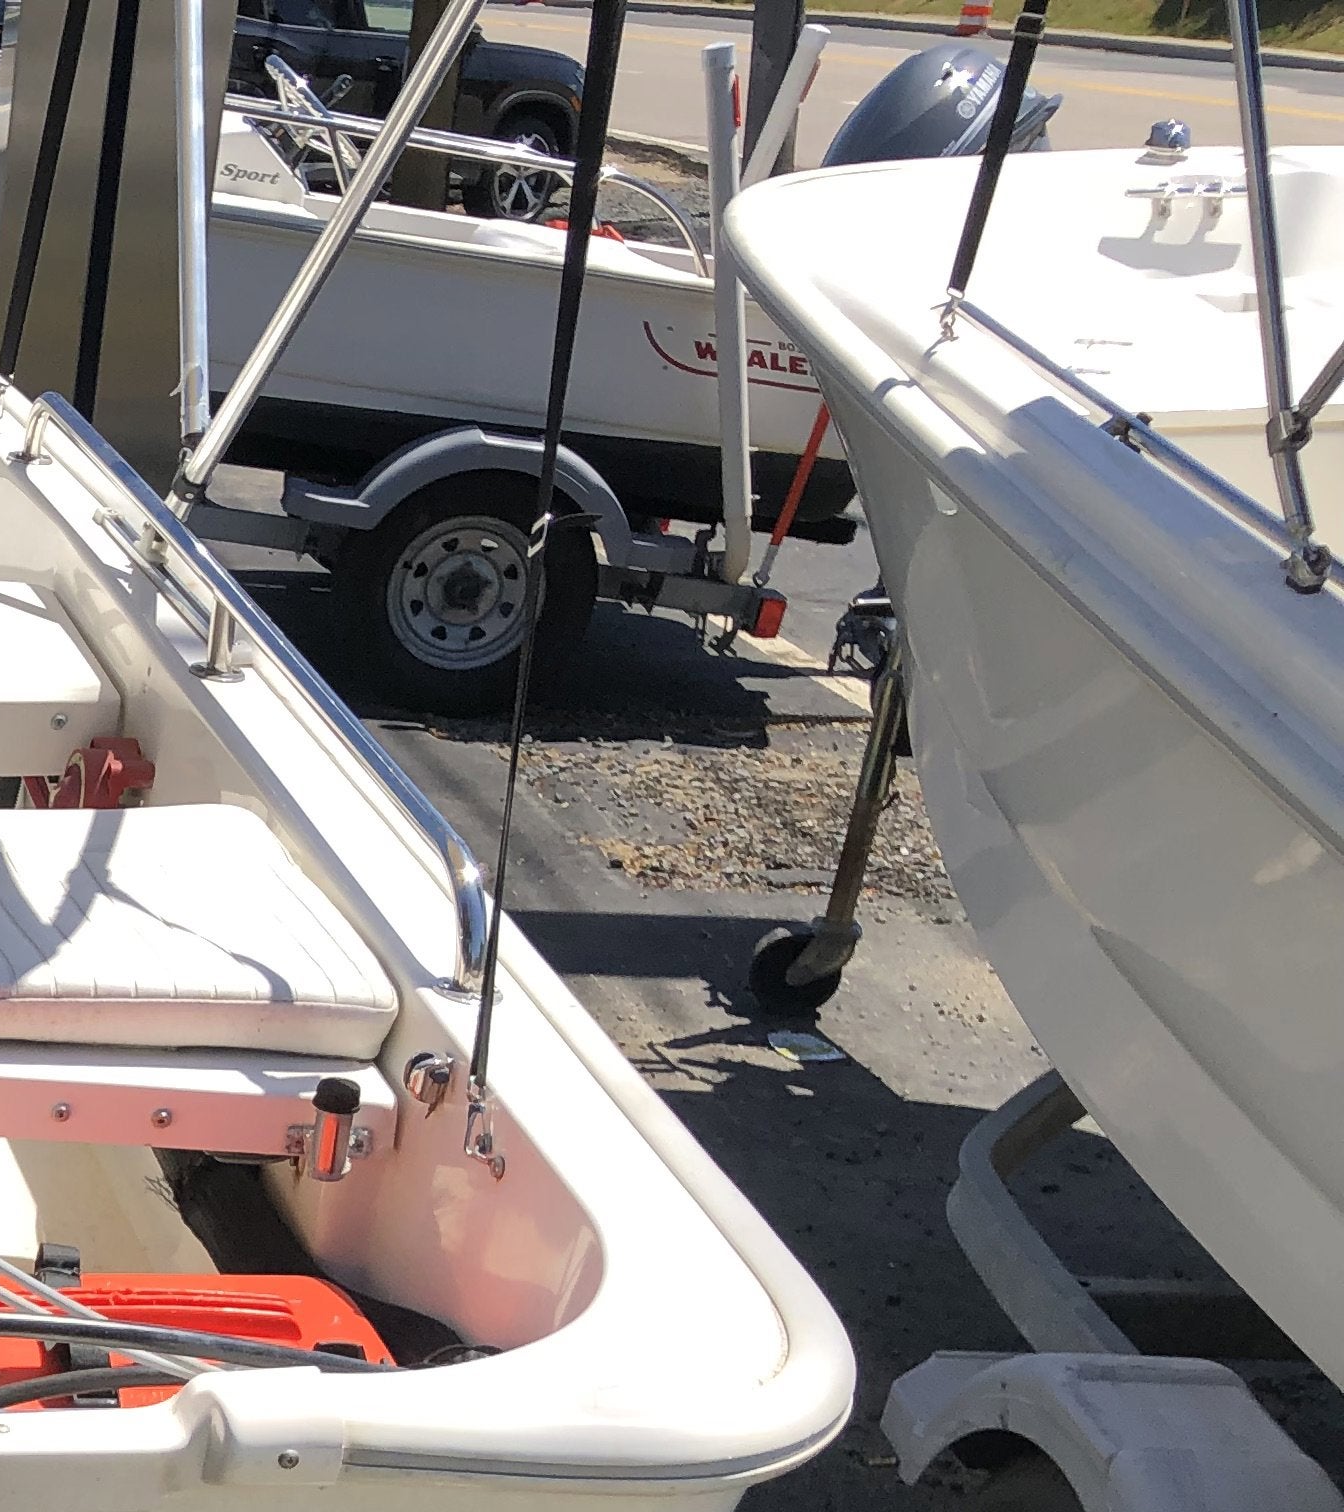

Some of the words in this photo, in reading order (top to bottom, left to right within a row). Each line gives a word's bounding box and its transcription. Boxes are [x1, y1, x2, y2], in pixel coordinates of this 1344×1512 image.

[966, 63, 1002, 106] YAMAHA
[219, 163, 281, 185] Sport
[694, 340, 810, 376] WALE
